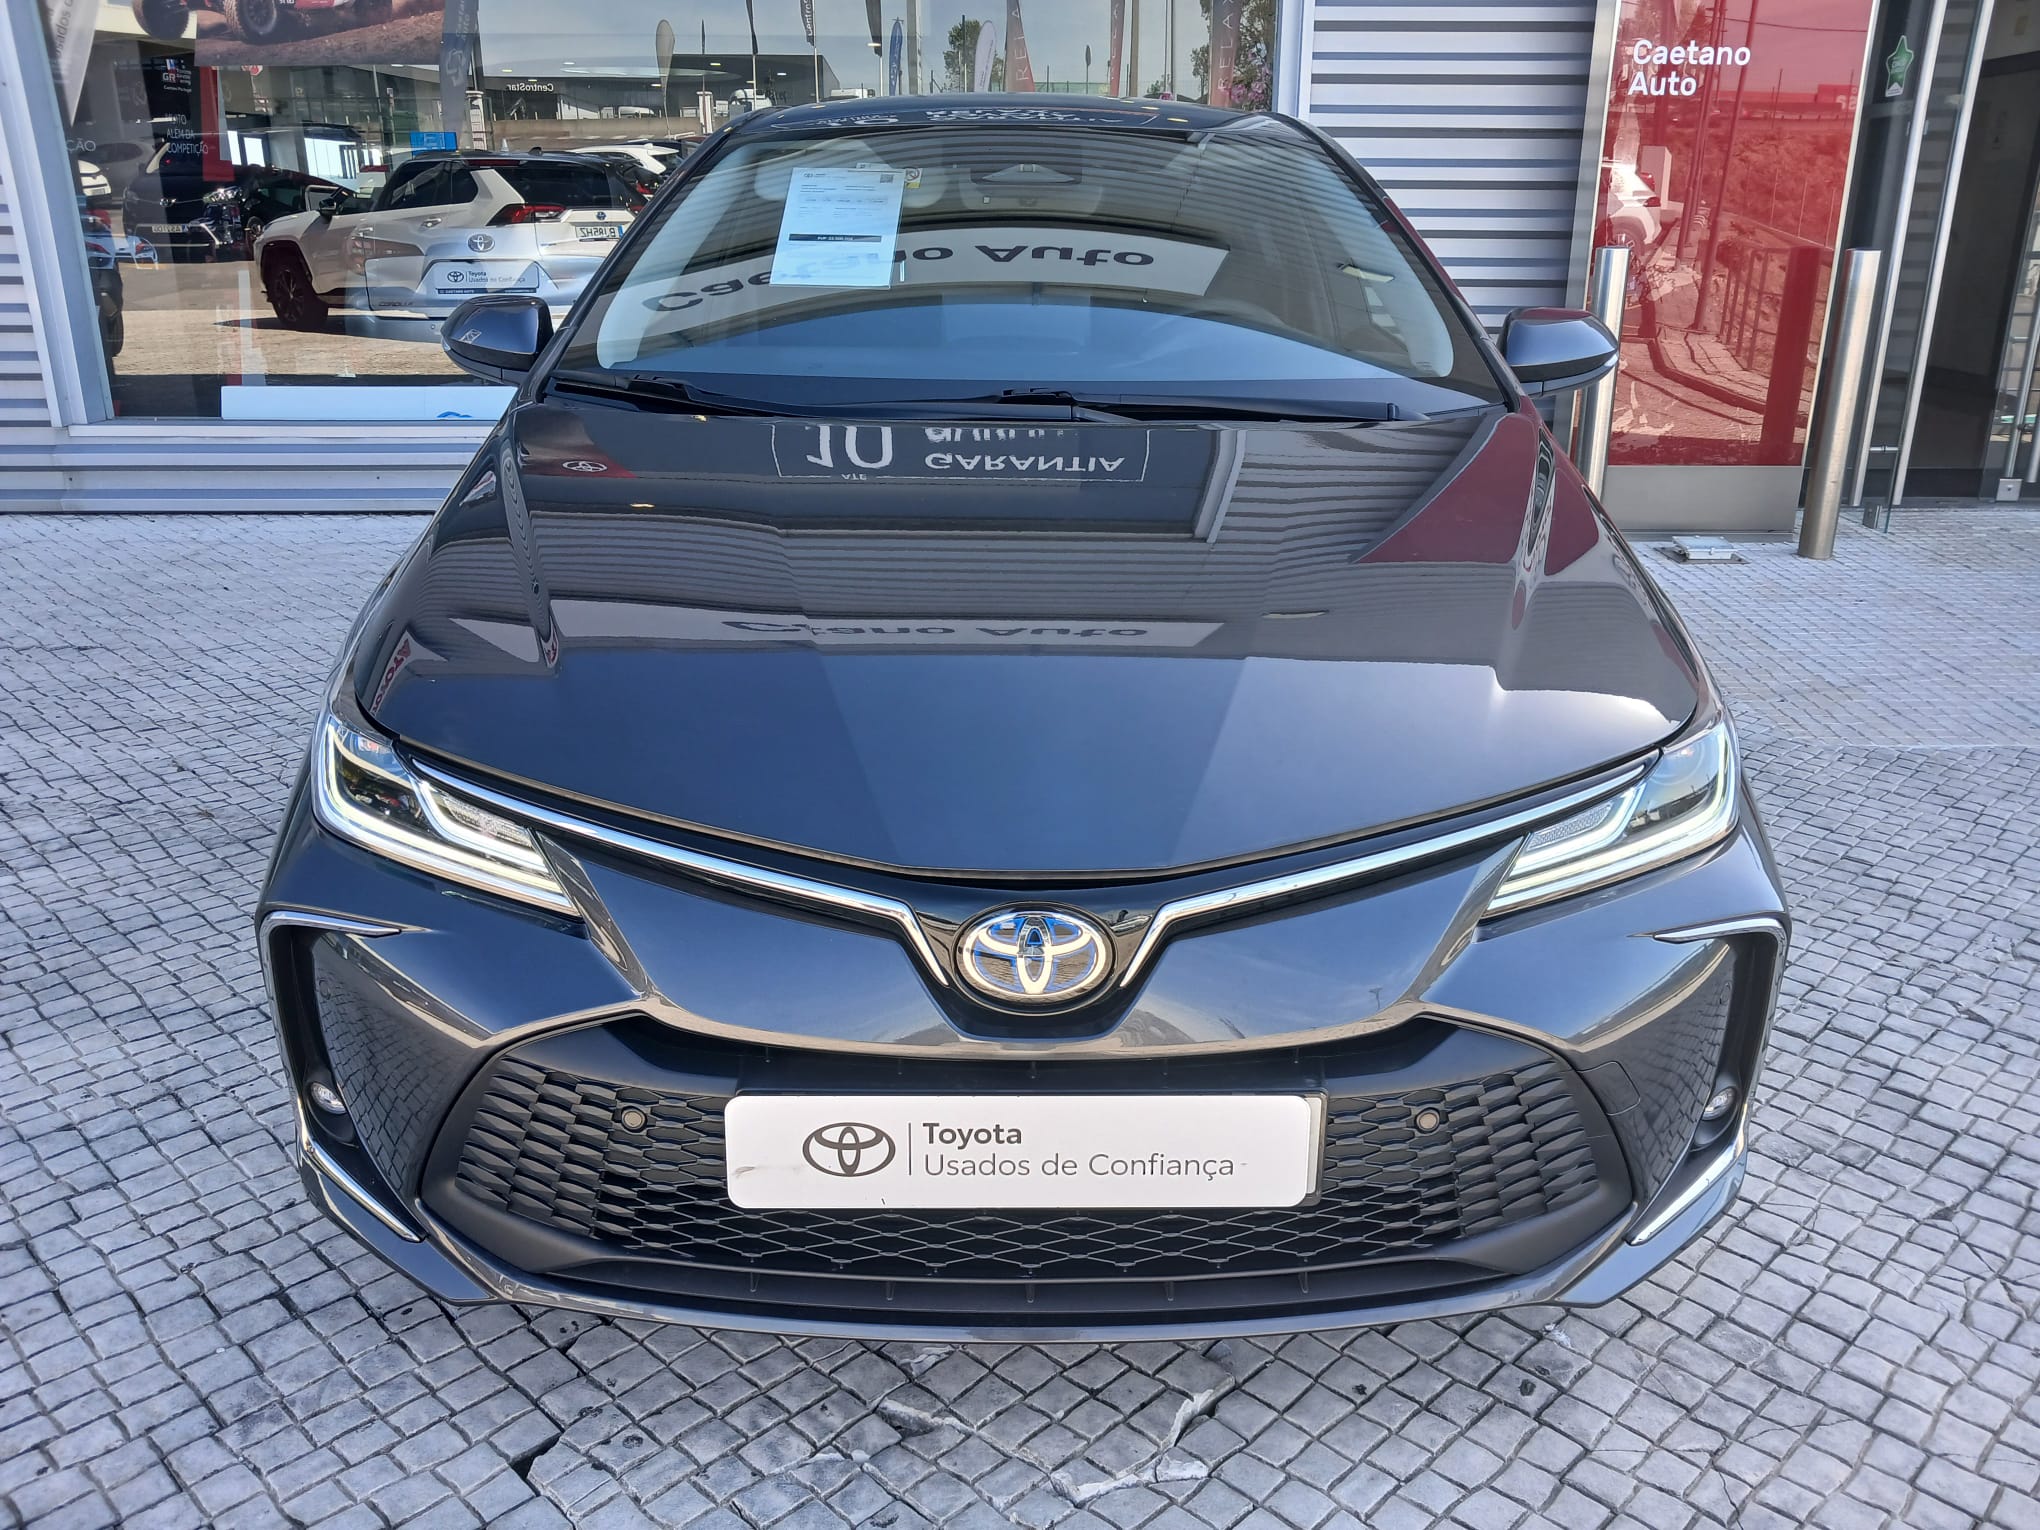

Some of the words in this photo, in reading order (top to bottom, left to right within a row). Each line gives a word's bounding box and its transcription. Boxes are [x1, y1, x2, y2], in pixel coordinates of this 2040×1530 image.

[1633, 39, 1751, 66] Caetano
[1627, 71, 1697, 96] Auto
[165, 113, 187, 125] ITO
[922, 1122, 1022, 1150] Toyota
[924, 1153, 1031, 1176] Usados
[1041, 1153, 1078, 1176] de
[1089, 1153, 1235, 1181] Confiança
